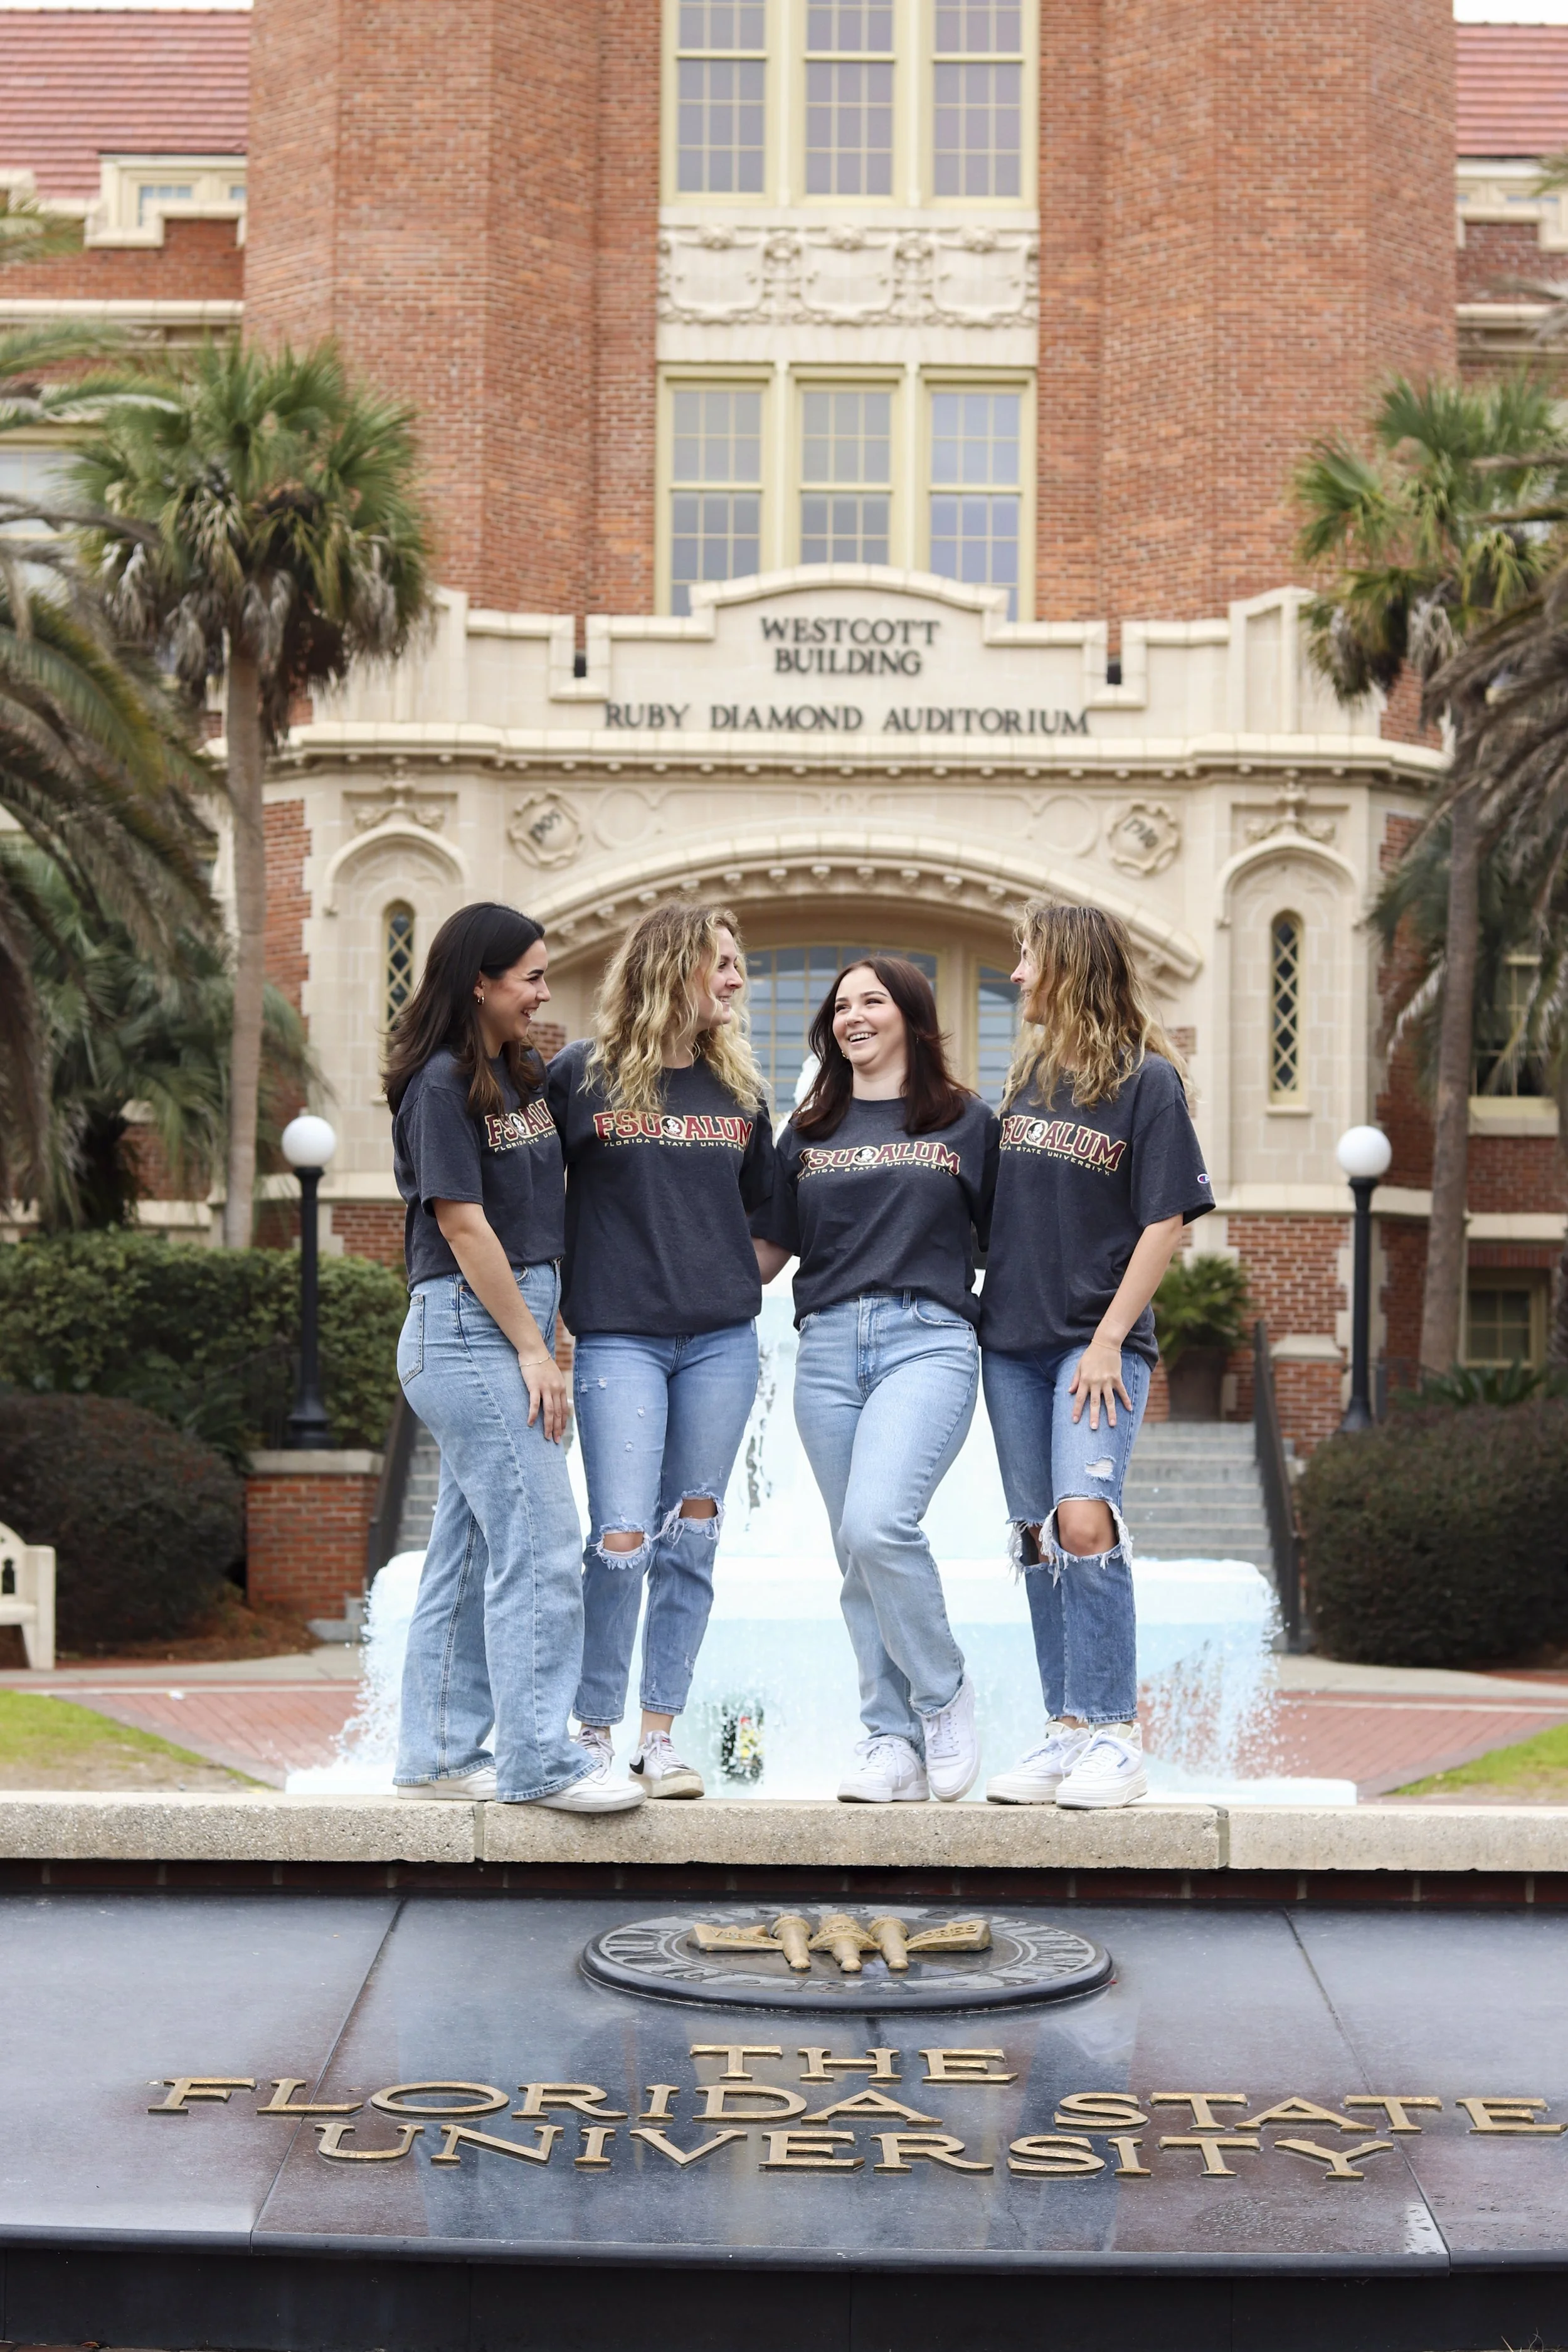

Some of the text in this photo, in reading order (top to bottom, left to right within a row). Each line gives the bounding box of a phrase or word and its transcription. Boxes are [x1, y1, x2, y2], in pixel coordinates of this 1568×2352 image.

[760, 617, 941, 645] WESTCOTT
[774, 649, 922, 675] BUILDING
[605, 702, 1089, 735] RUBY DIAMOND AUDITORIUM
[593, 1109, 663, 1141] FSU
[604, 1138, 650, 1147] FLORIDA
[872, 1141, 960, 1175] ALUM
[1038, 1120, 1127, 1172] ALUM
[1016, 1146, 1041, 1155] STATE
[1047, 1151, 1109, 1175] UNIVERSITY
[689, 2043, 1019, 2084] THE
[147, 2077, 1567, 2134] FLORIDA STATE
[314, 2121, 1394, 2181] UNIVERSITY
